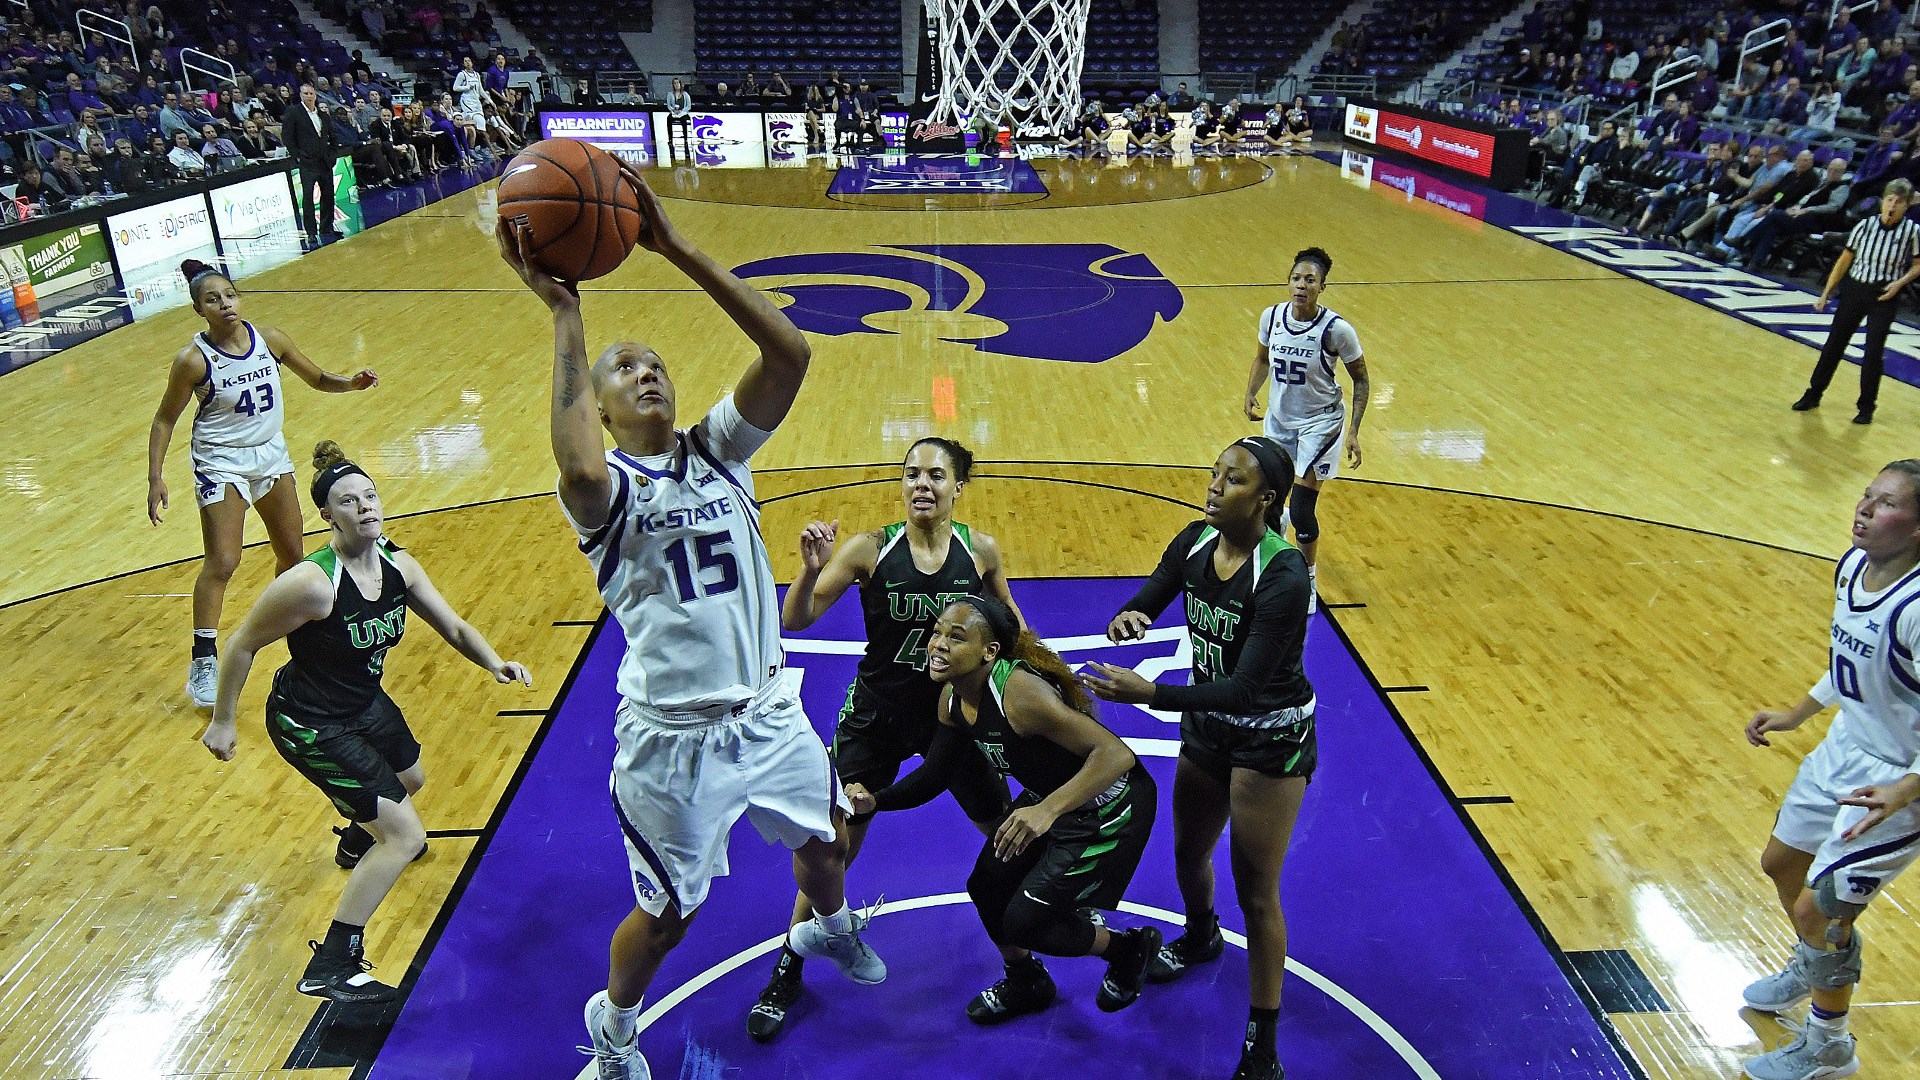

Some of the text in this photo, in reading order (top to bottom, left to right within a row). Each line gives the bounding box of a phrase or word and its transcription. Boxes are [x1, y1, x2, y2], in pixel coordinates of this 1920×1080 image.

[929, 40, 937, 90] WILDCATS
[238, 201, 254, 217] Via
[254, 193, 282, 212] Christi
[114, 223, 151, 248] POINTE
[164, 209, 208, 234] DISTRICT
[28, 231, 80, 271] THANK YOU
[44, 254, 76, 279] FARMERS
[1271, 343, 1315, 359] K-STATE
[221, 365, 272, 389] K-STATE
[1273, 358, 1308, 386] 25
[234, 382, 275, 418] 43
[635, 496, 733, 534] K-STATE
[662, 529, 740, 605] 15
[346, 604, 405, 649] UNT
[1186, 591, 1241, 642] UNT
[893, 628, 929, 672] 4
